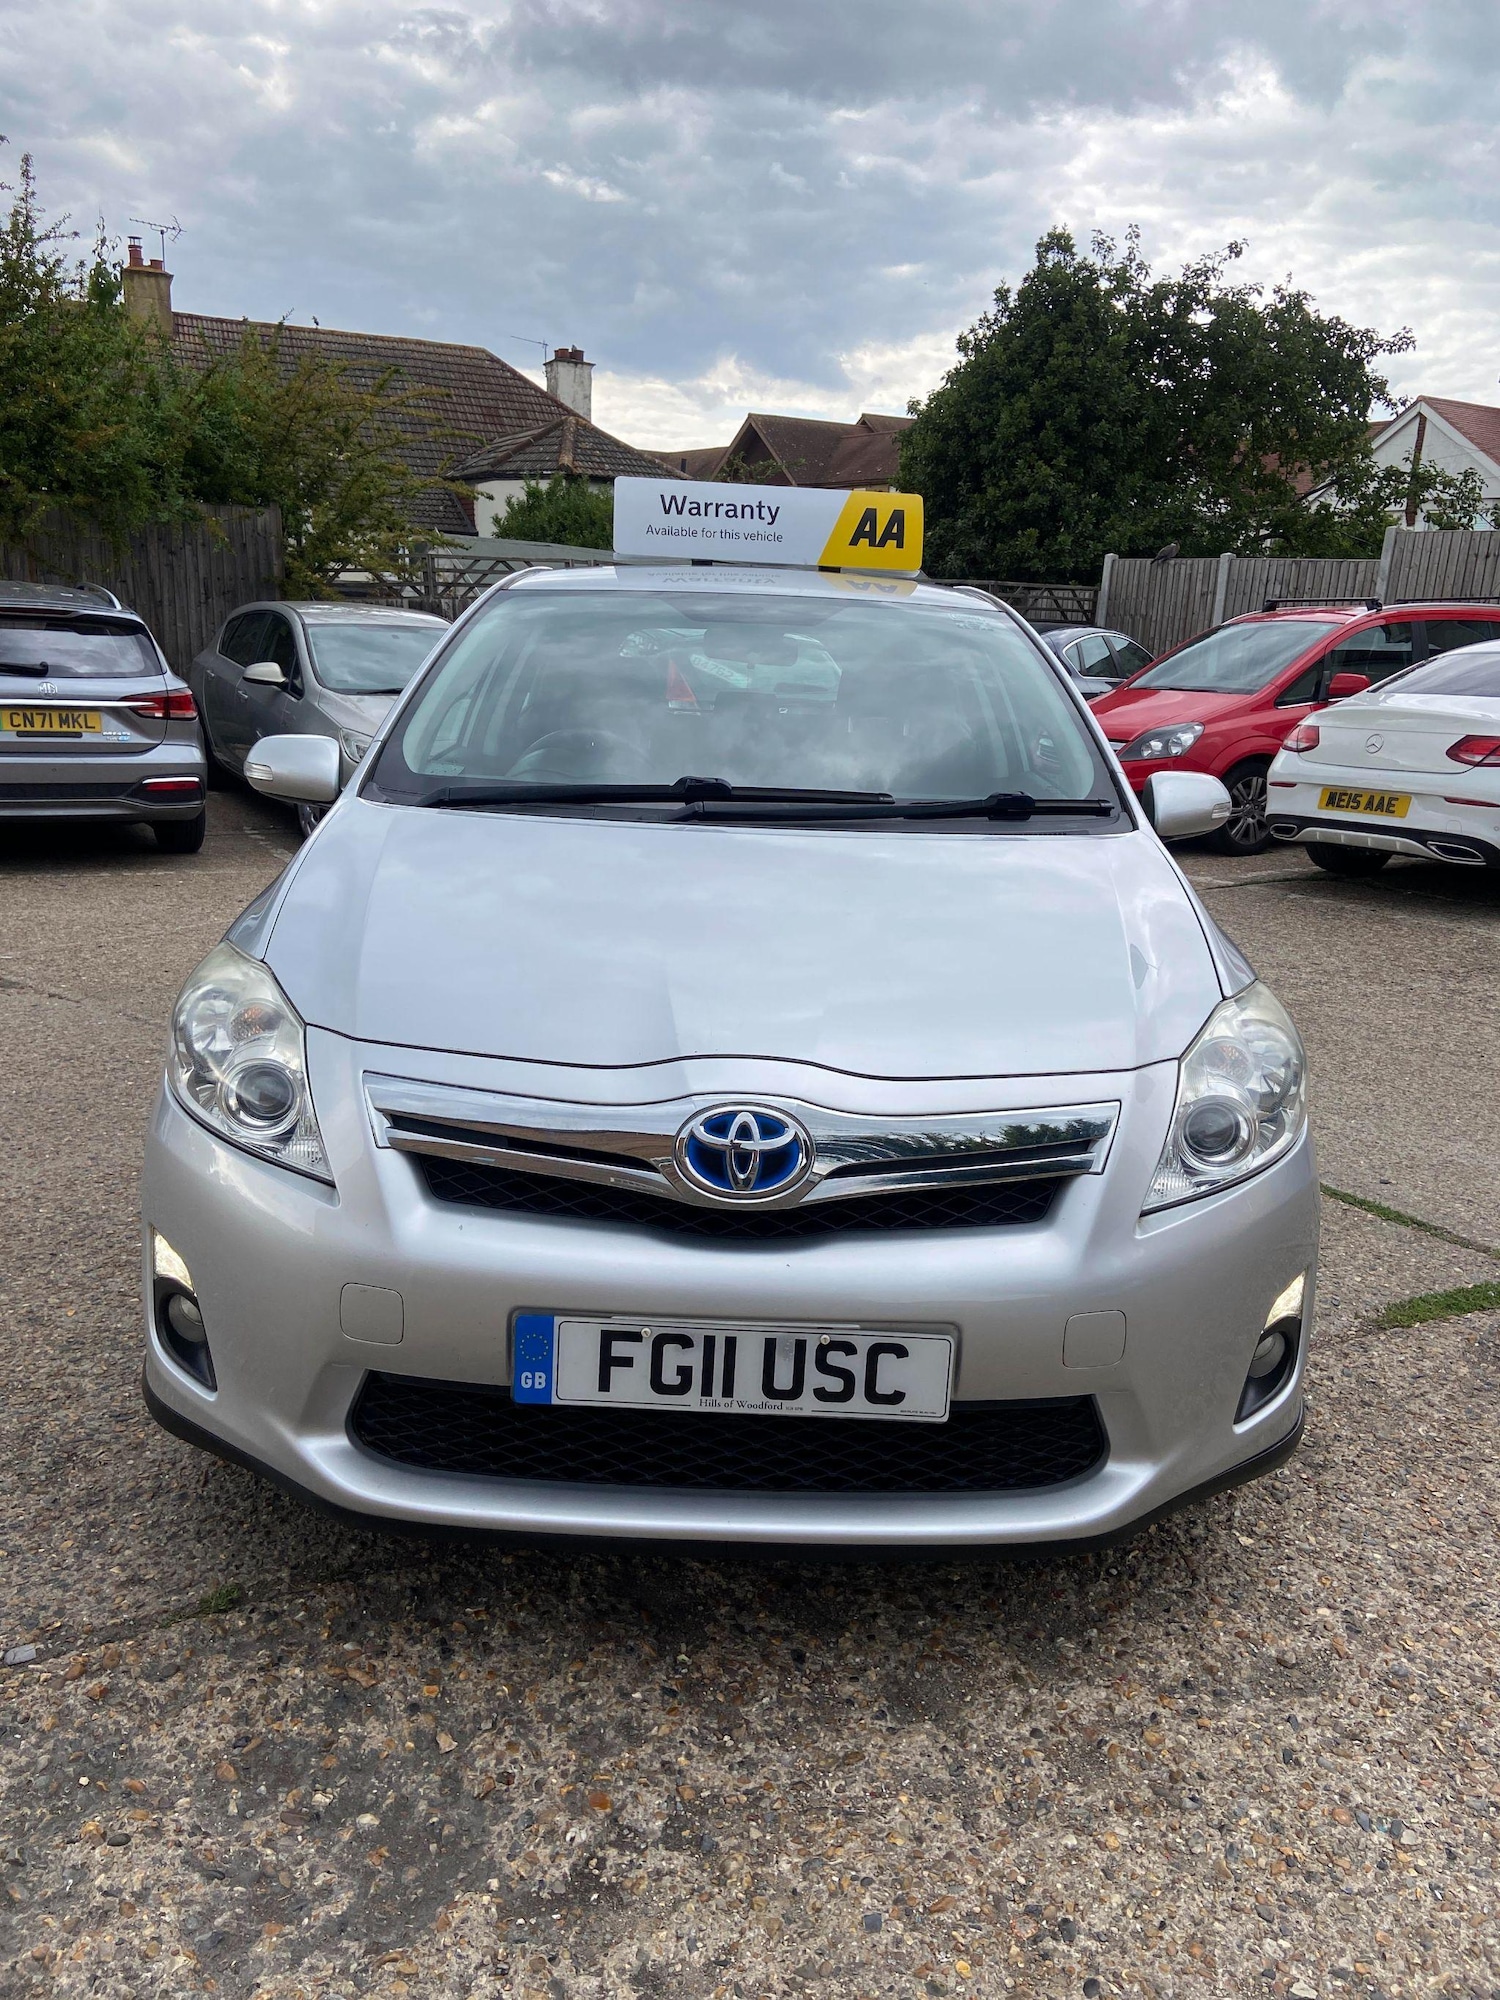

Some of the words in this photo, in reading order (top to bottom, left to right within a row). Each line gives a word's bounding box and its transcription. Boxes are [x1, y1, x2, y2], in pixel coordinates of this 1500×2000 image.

[659, 493, 781, 526] Warranty
[646, 524, 699, 538] Available
[701, 527, 718, 539] for
[719, 528, 741, 541] this
[743, 530, 784, 543] vehicle
[848, 507, 905, 549] AA
[9, 712, 54, 728] CN71
[59, 712, 96, 730] MKL
[1363, 794, 1400, 814] AAE
[597, 1329, 738, 1399] FG11
[761, 1336, 910, 1407] USC
[520, 1371, 546, 1389] GB
[699, 1398, 721, 1408] Hills
[723, 1399, 735, 1408] of
[735, 1400, 783, 1411] Woodford
